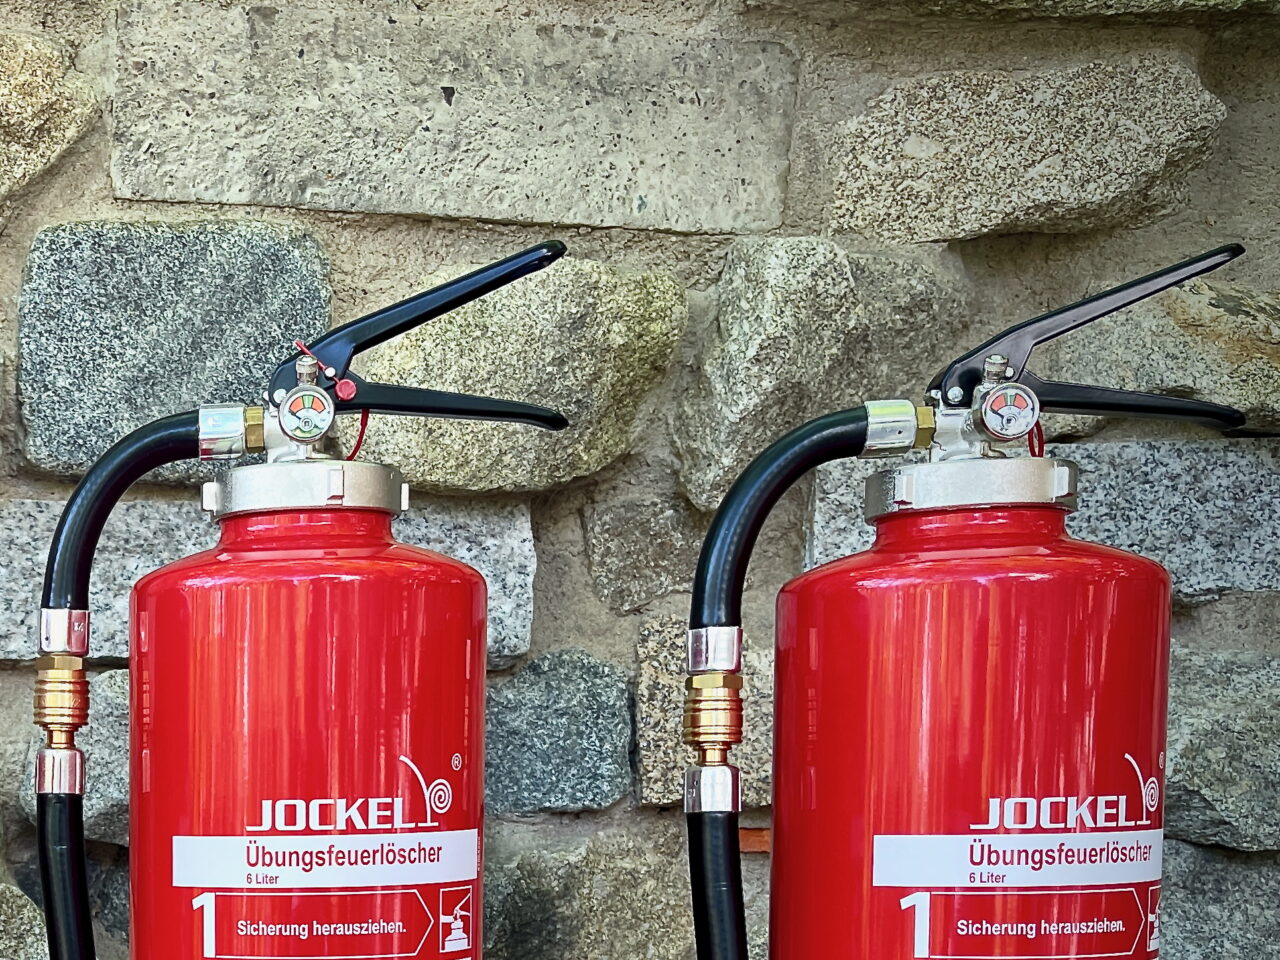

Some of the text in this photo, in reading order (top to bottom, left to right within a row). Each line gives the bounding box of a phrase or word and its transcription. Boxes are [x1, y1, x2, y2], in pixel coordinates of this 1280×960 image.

[245, 798, 416, 832] JOCKEL
[970, 795, 1135, 832] JOCKEL
[247, 840, 442, 872] Übungsfeuerlöscher
[970, 839, 1152, 871] Übungsfeuerlöscher
[246, 872, 279, 885] 6 Liter
[968, 871, 1006, 884] 6 Liter
[192, 892, 215, 958] 1
[238, 919, 406, 939] Sicherung herausziehen.
[900, 892, 930, 958] 1
[957, 918, 1125, 938] Sicherung herausziehen.
